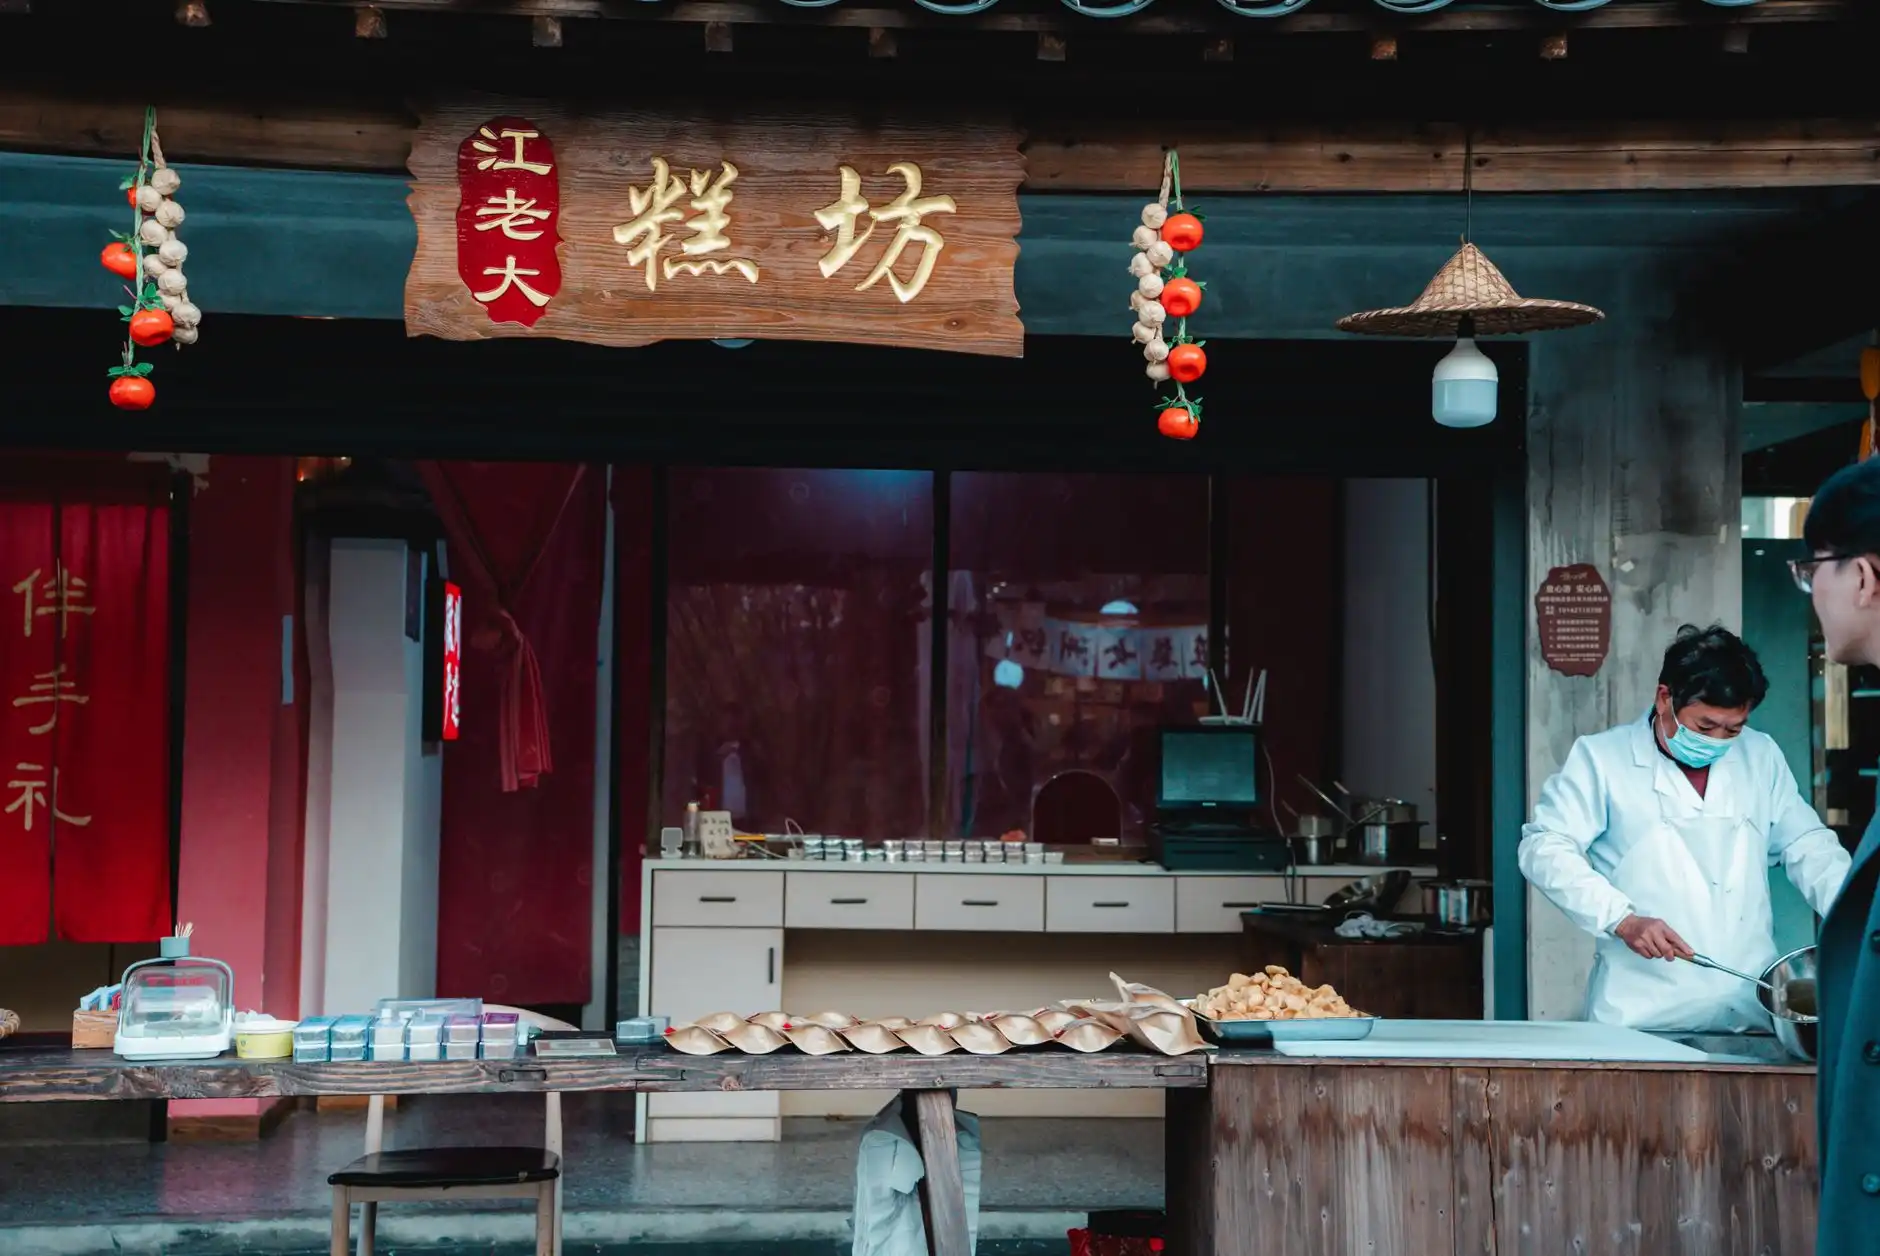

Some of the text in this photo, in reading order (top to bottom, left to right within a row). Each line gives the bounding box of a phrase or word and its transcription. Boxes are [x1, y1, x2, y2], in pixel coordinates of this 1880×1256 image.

[473, 126, 553, 308] 江老大
[613, 156, 957, 303] 糕坊
[5, 567, 97, 832] 伴手礼
